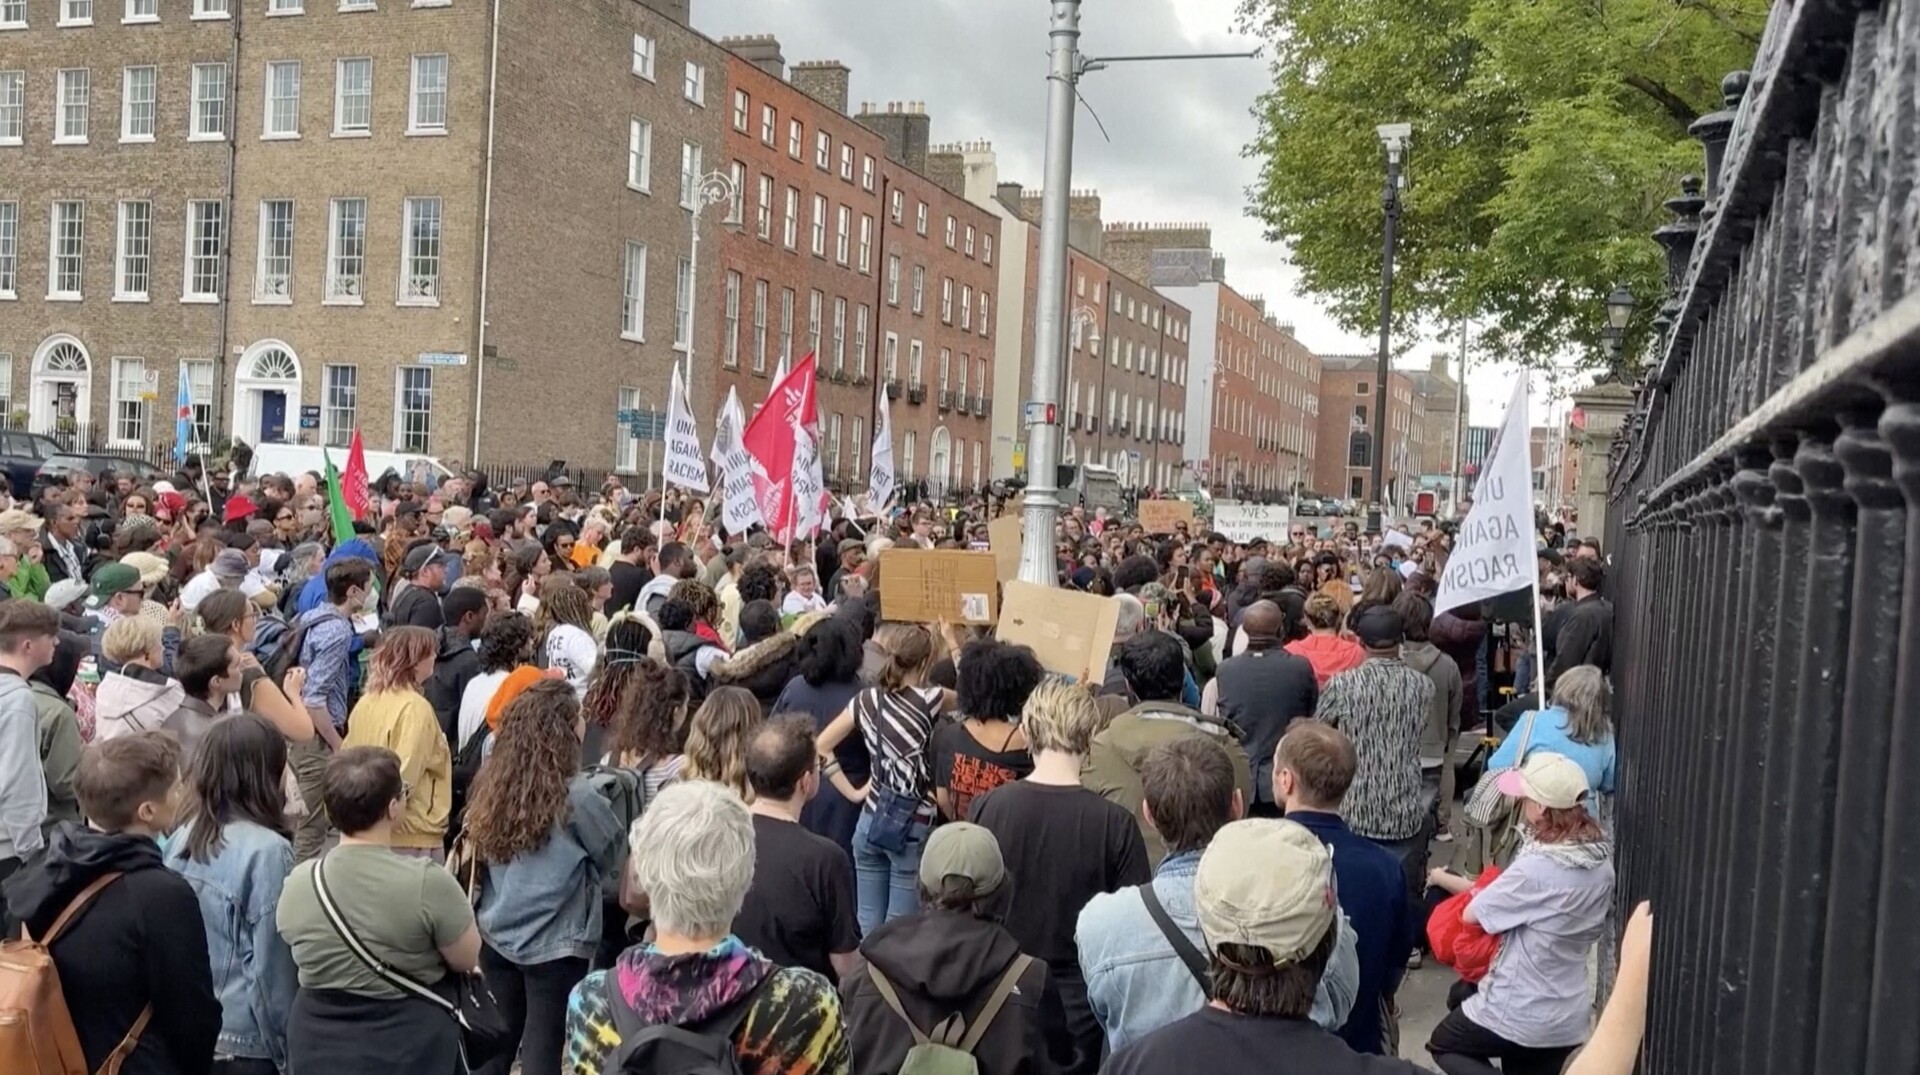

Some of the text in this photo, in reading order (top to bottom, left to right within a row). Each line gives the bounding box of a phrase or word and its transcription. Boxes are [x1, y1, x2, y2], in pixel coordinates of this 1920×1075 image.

[676, 419, 696, 437] UNI
[668, 459, 706, 483] RACISM
[871, 465, 891, 488] INST
[1241, 506, 1269, 519] YVES
